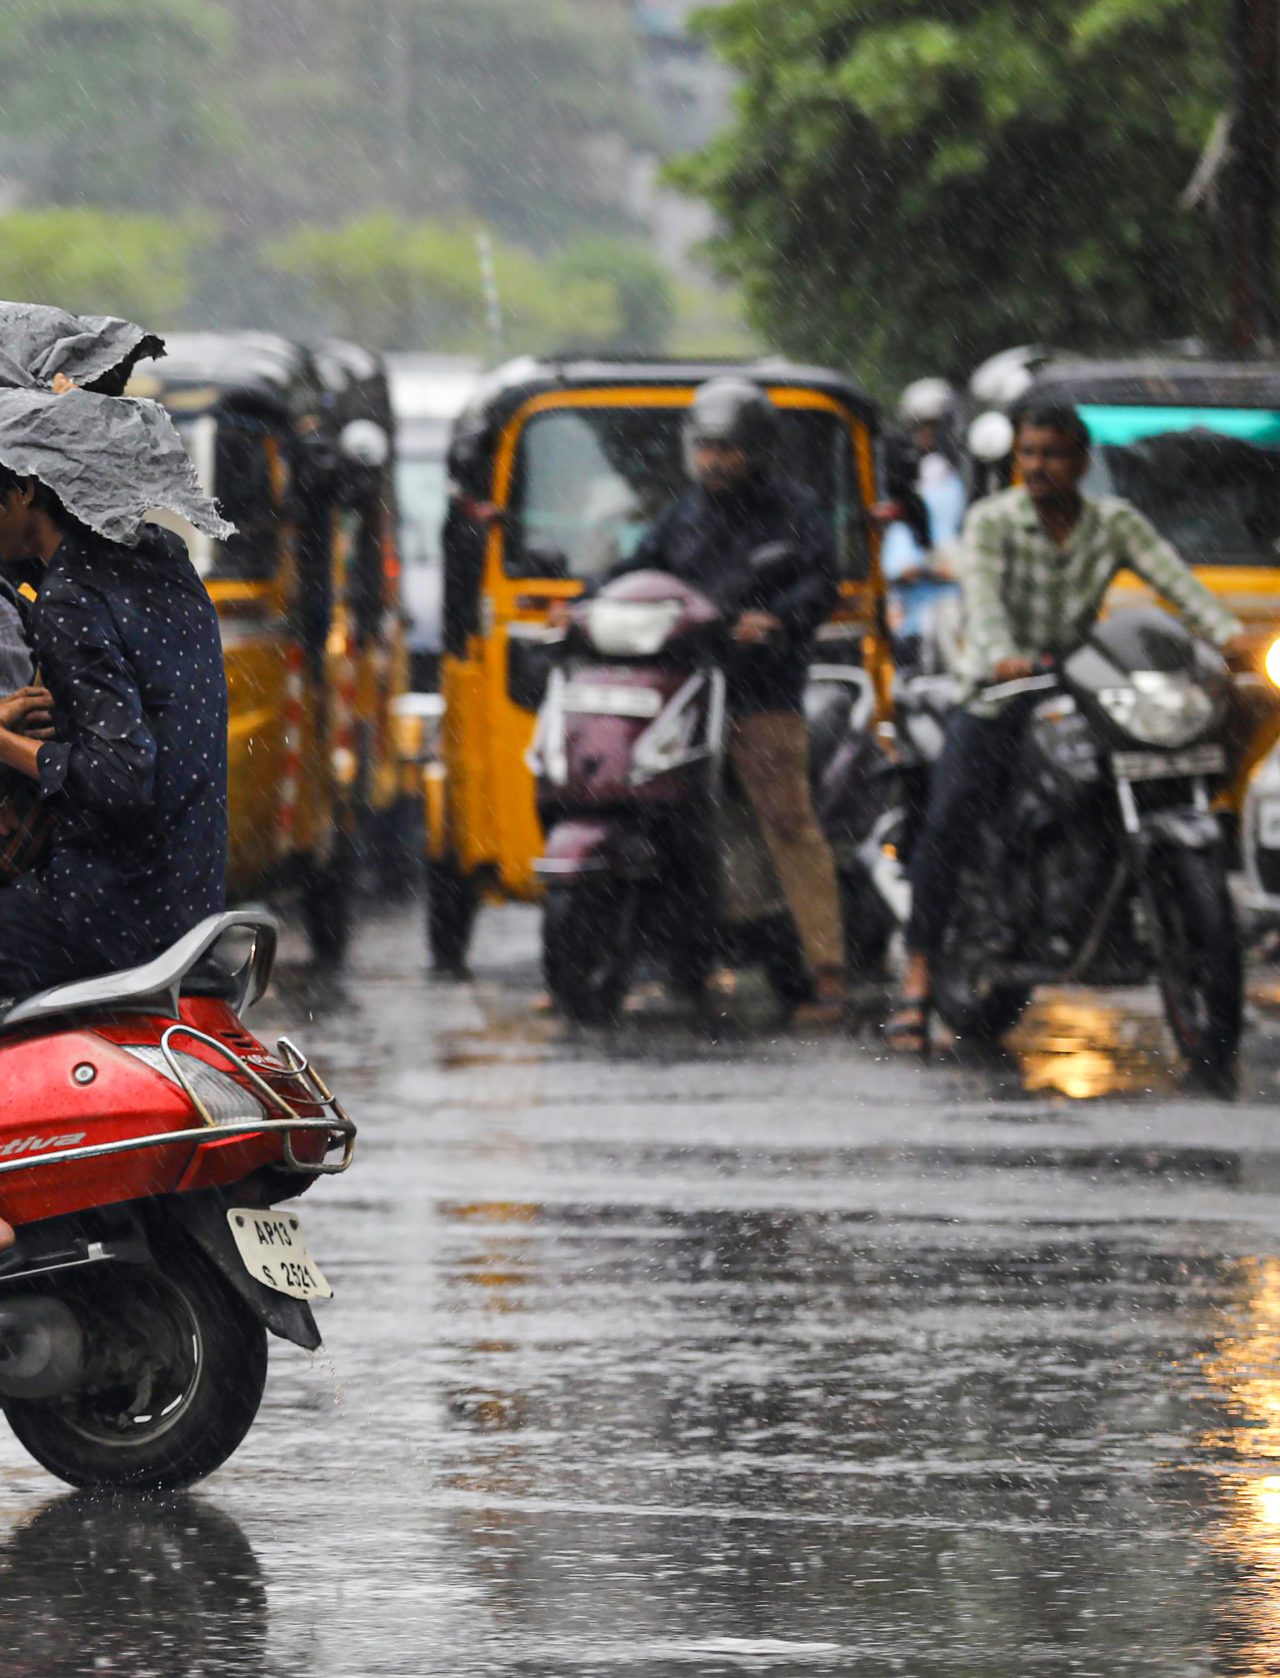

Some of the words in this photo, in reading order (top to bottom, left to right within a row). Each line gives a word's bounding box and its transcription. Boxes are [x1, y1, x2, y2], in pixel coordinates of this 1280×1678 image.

[254, 1220, 292, 1246] AP13
[262, 1265, 277, 1286] S
[280, 1262, 317, 1288] 2521
